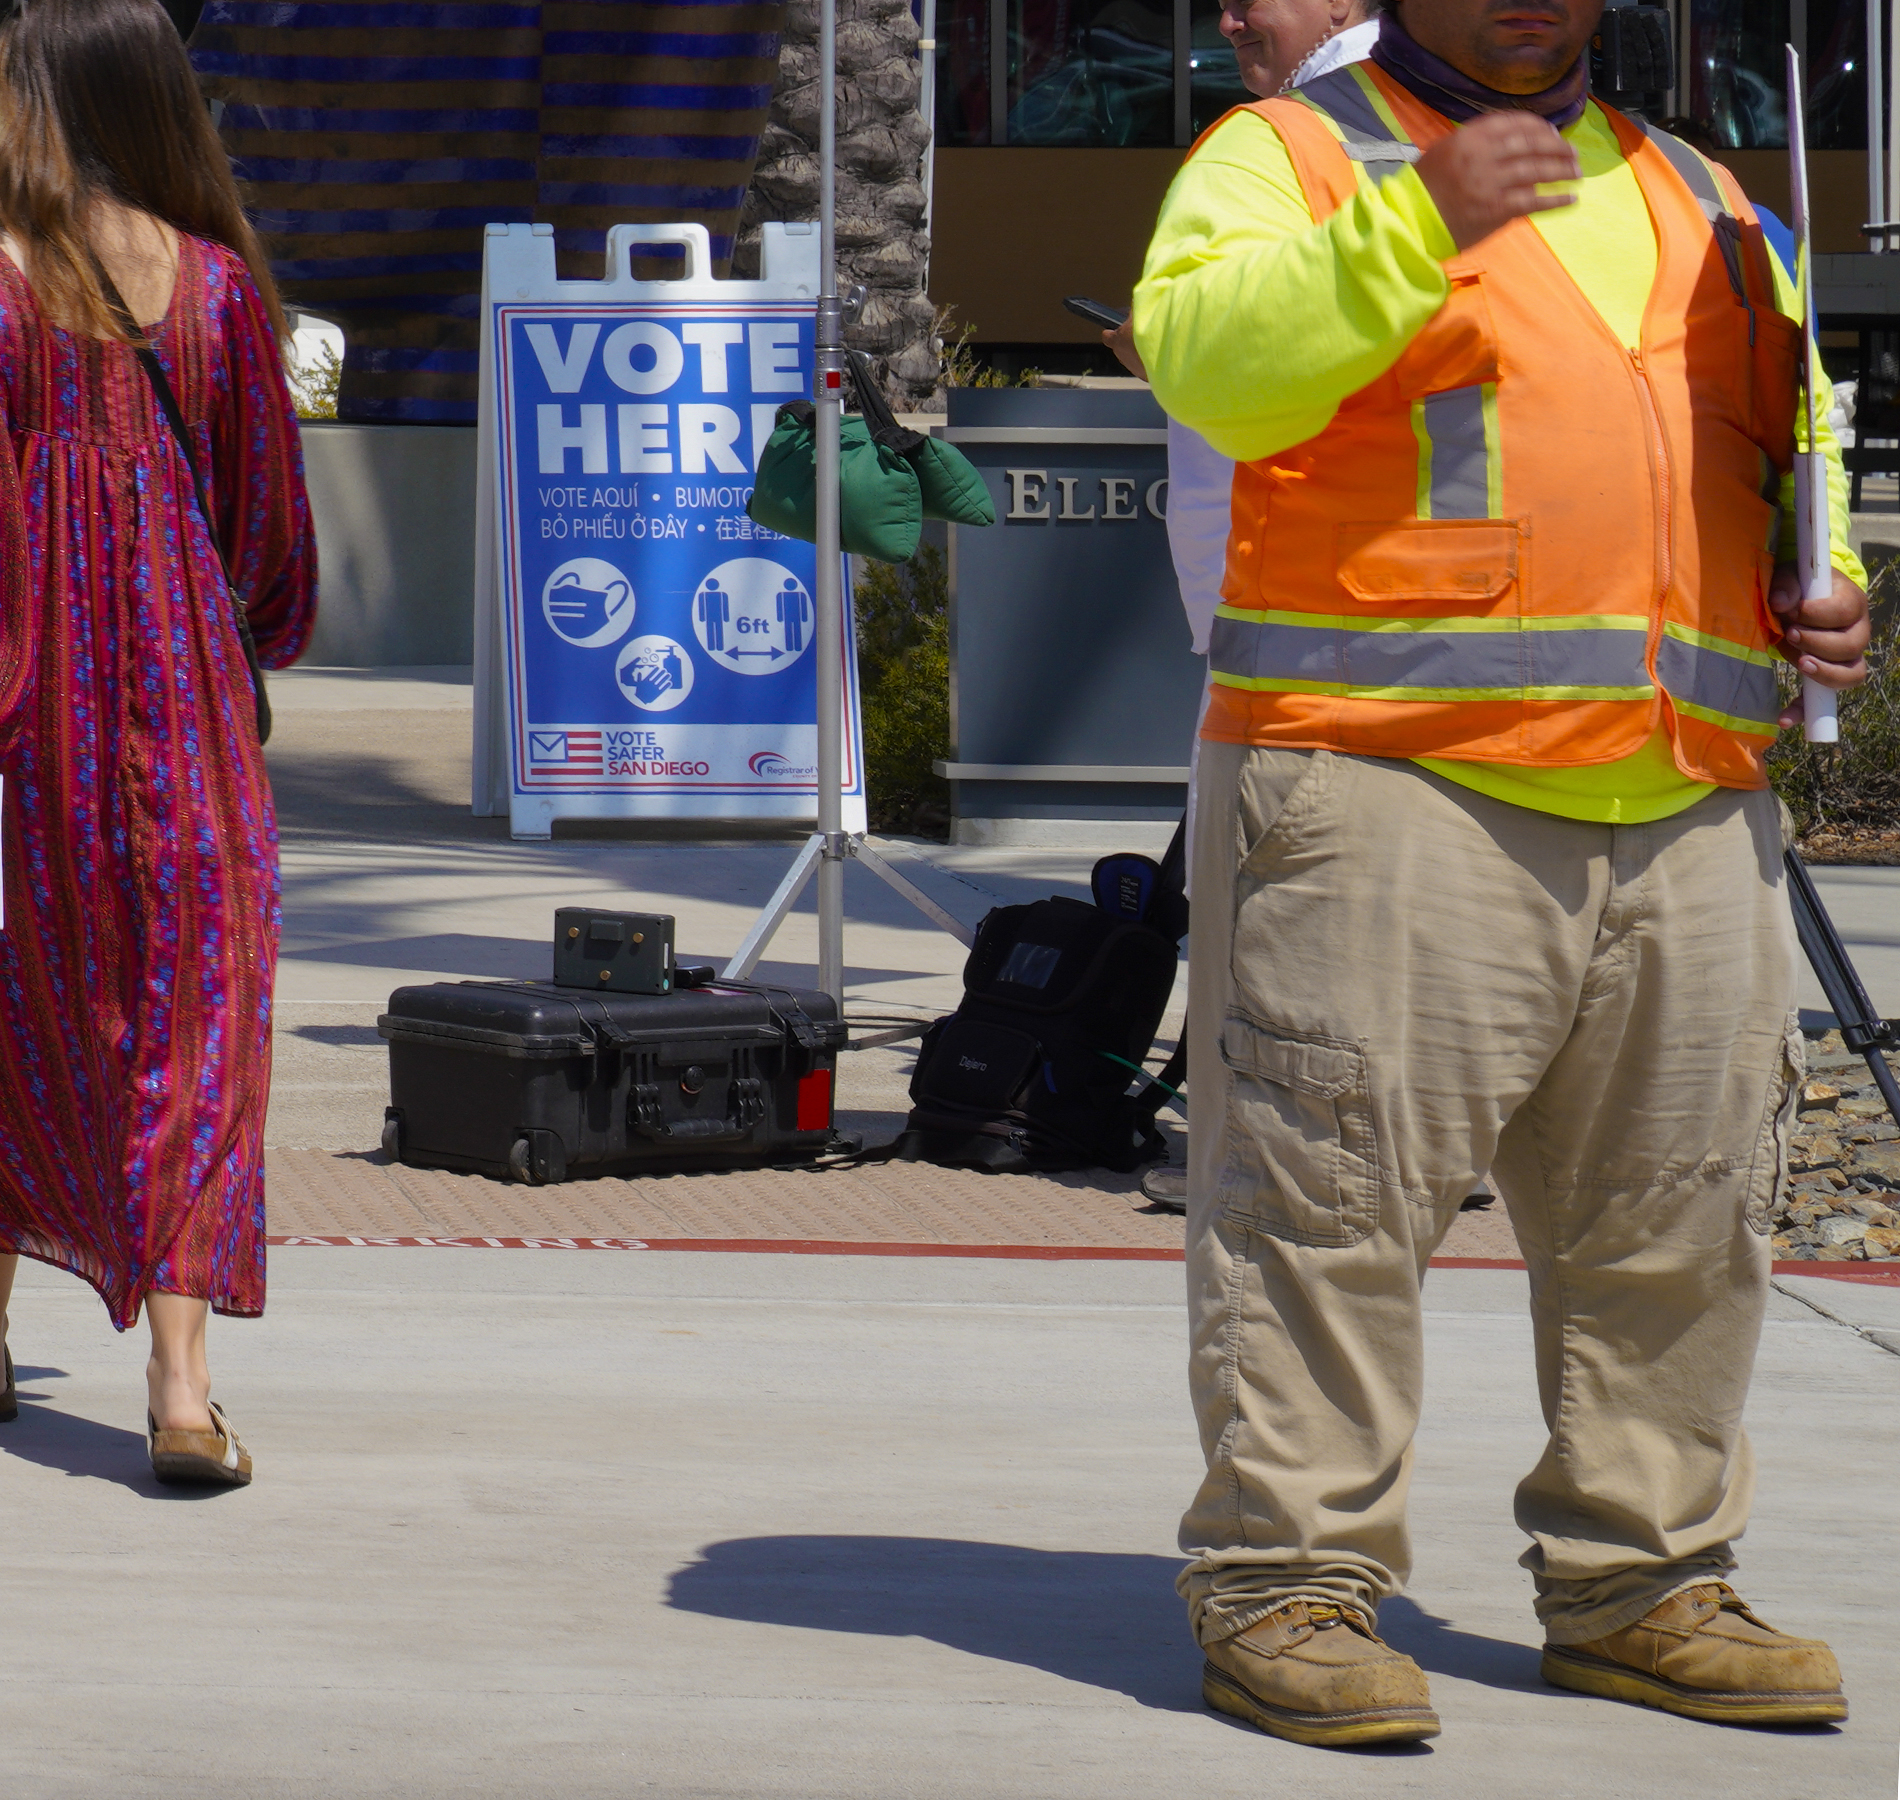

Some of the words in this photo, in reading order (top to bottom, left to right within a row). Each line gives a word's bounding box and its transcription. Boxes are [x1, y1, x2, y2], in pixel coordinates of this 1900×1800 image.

[524, 322, 804, 395] VOTE
[538, 487, 586, 508] VOTE
[592, 482, 639, 508] AQUÍ
[541, 513, 568, 539] BỎ
[573, 511, 625, 539] PHIẾU
[651, 514, 689, 539] ĐÂY
[736, 616, 770, 634] 6ft
[606, 732, 656, 746] VOTE
[608, 746, 664, 761] SAFER
[608, 761, 649, 776] SAN
[651, 761, 710, 776] DIEGO
[767, 766, 804, 776] Registrar
